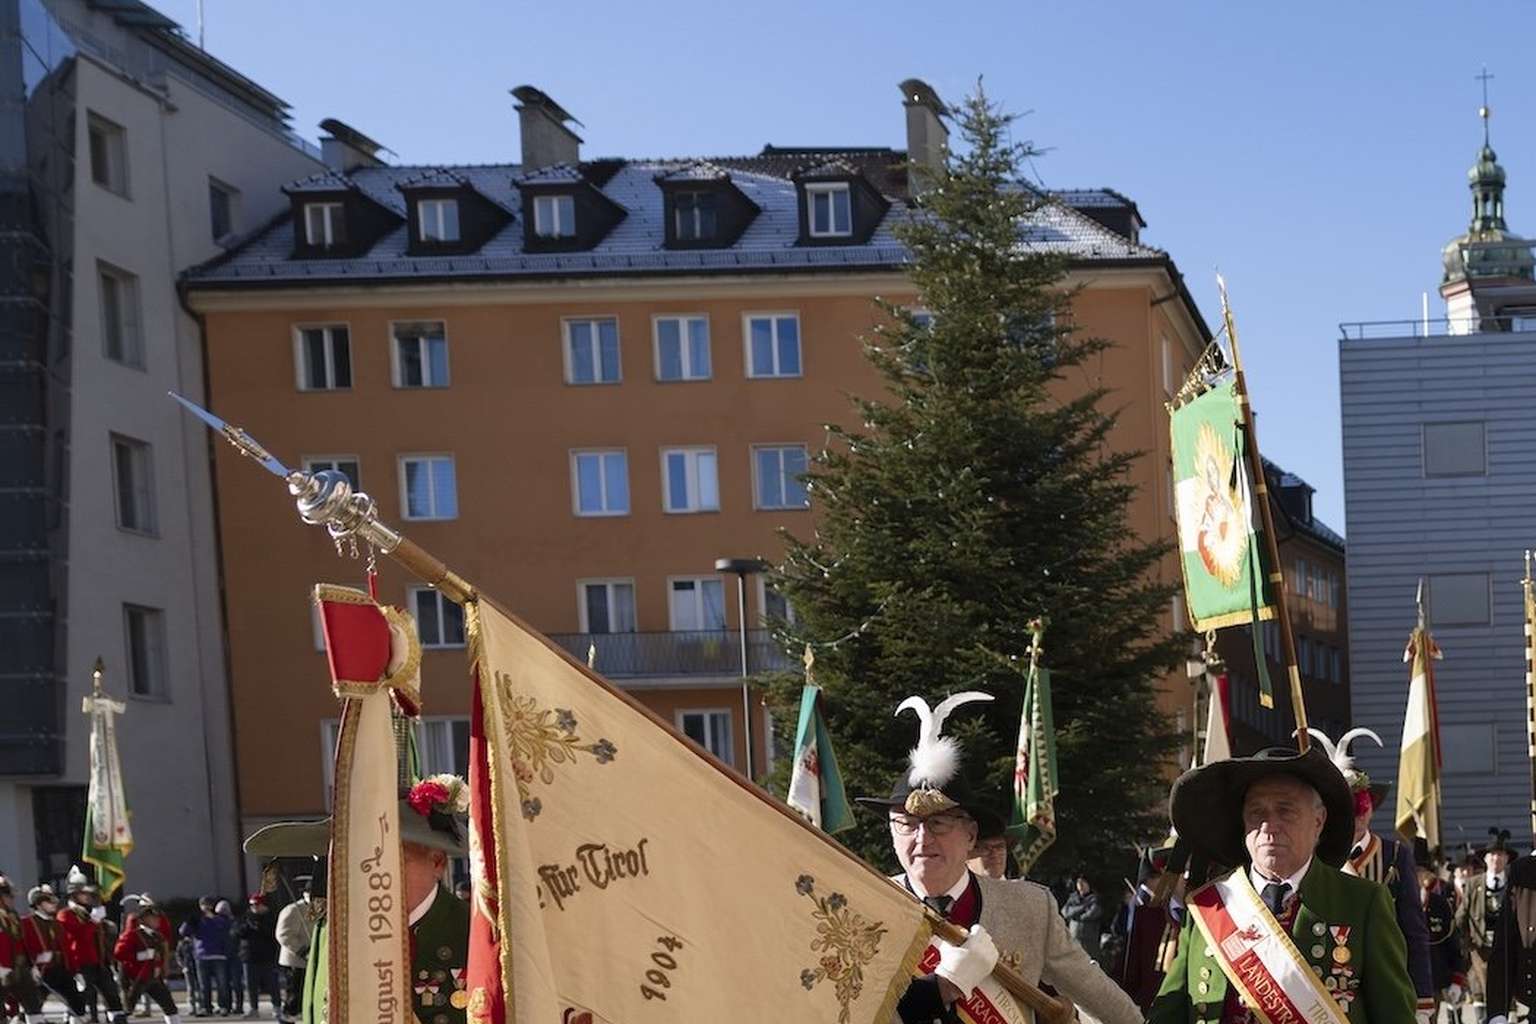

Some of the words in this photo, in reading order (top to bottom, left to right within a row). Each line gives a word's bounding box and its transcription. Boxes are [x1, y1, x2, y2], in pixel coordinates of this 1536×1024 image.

[576, 838, 650, 890] Tirol
[368, 872, 393, 944] 1988
[640, 936, 683, 1001] 1904
